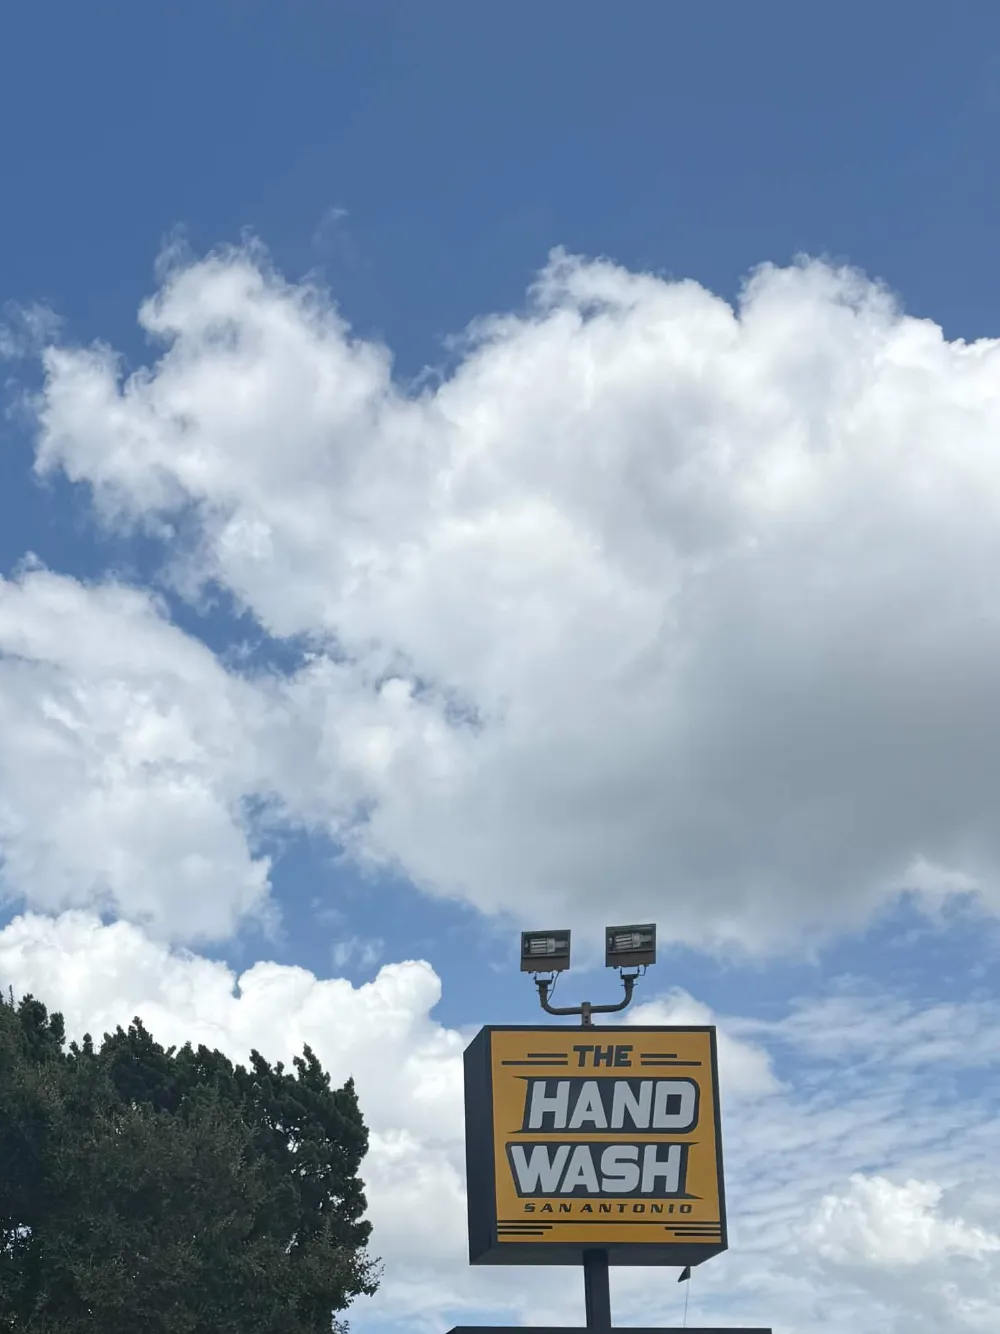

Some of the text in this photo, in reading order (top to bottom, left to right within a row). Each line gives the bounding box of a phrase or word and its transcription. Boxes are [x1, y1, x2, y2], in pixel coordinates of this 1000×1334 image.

[573, 1045, 633, 1067] THE
[528, 1080, 696, 1129] HAND
[510, 1145, 681, 1193] WASH
[524, 1202, 693, 1214] SAN ANTONIO
